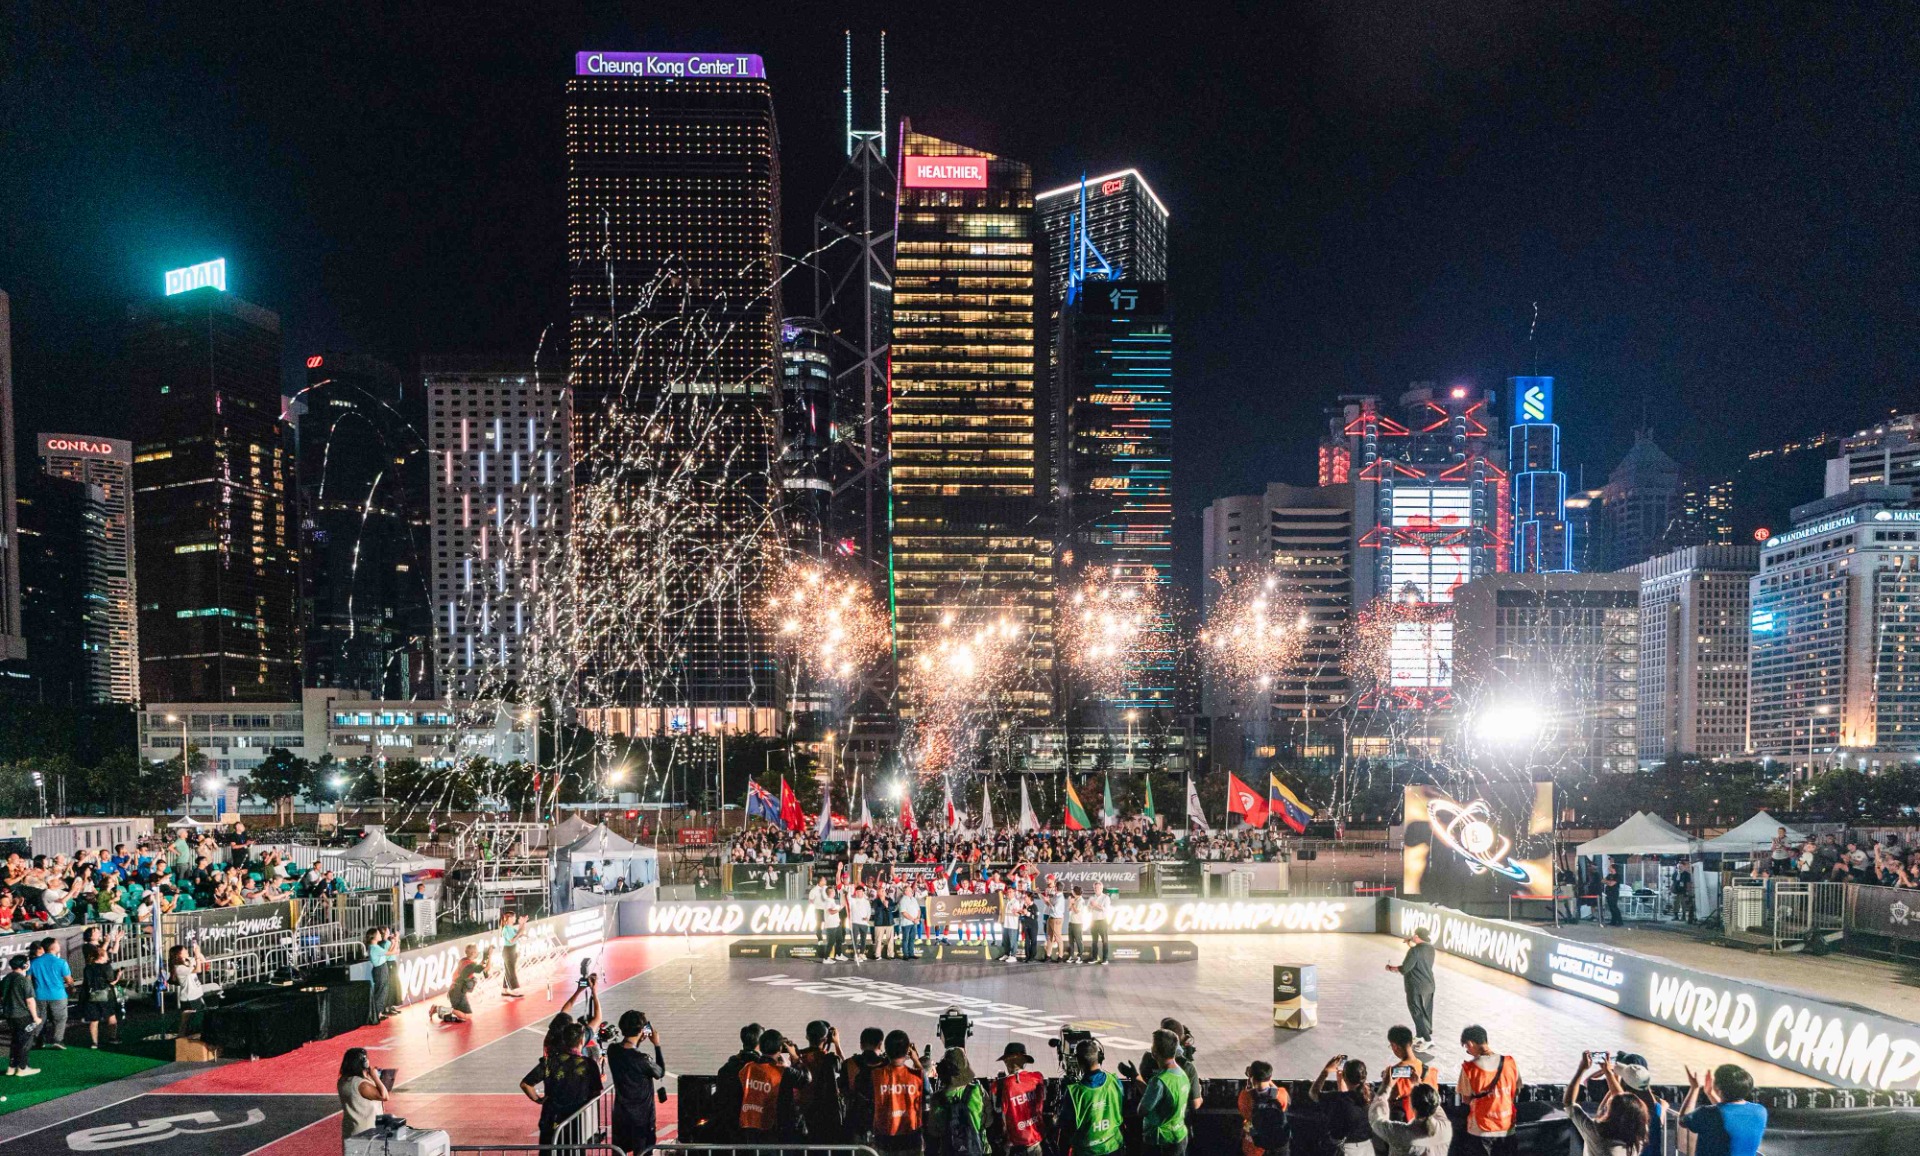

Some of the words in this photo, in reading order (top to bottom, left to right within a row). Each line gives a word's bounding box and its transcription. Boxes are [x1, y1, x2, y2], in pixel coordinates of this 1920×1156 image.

[588, 54, 642, 76] Cheung
[647, 57, 685, 77] Kong
[688, 57, 734, 75] Center
[917, 165, 982, 180] HEALTHIER,
[1109, 288, 1138, 310] 行
[47, 439, 112, 454] CONRAD
[1780, 526, 1818, 544] MANDARIN
[1818, 514, 1855, 533] ORIENTAL
[1044, 871, 1137, 882] PLAYEVERYWHERE
[952, 905, 998, 917] CHAMPIONS
[960, 898, 988, 908] WORLD
[648, 903, 744, 933] WORLD
[1174, 901, 1346, 932] CHAMPIONS
[1442, 917, 1532, 975] CHAMPIONS
[1548, 952, 1595, 979] WORLD
[1593, 965, 1624, 987] CUP
[1649, 972, 1758, 1046] WORLD
[745, 1078, 771, 1093] HOTO
[880, 1083, 916, 1095] PHOTO
[1092, 1119, 1110, 1132] HB
